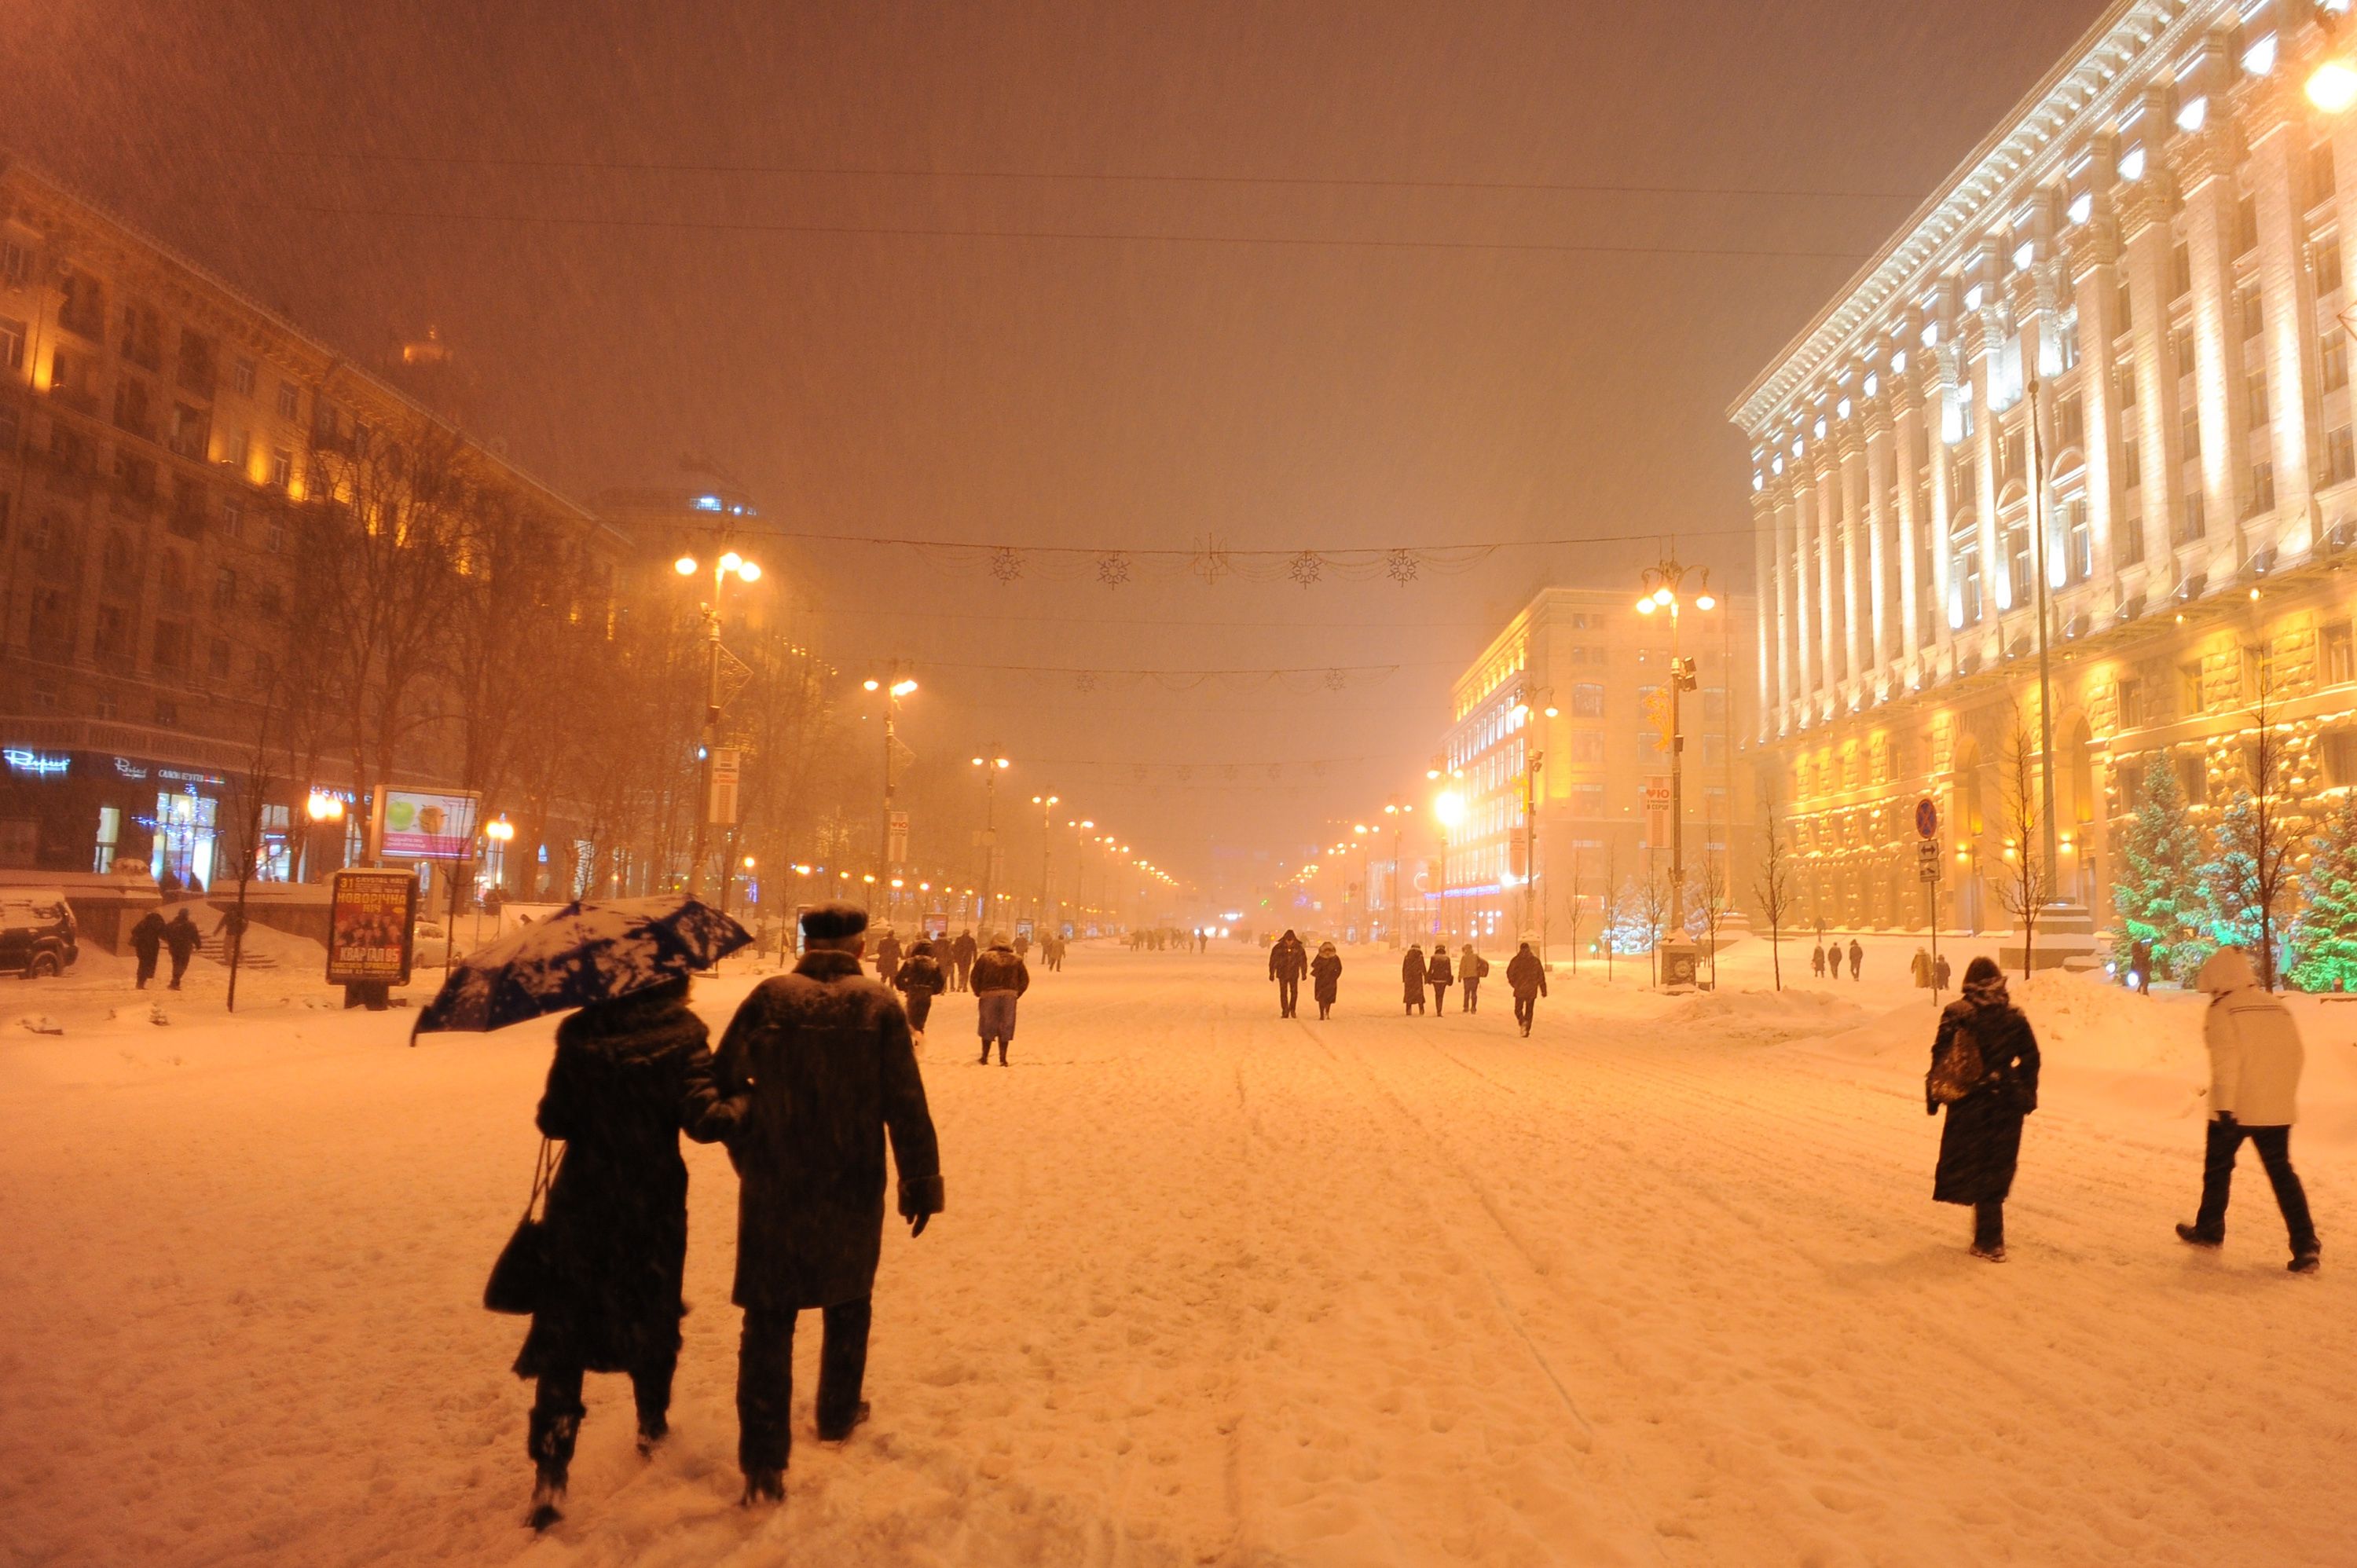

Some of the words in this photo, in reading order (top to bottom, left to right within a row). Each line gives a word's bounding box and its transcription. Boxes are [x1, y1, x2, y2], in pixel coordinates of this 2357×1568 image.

[340, 878, 354, 888] 31
[337, 893, 406, 904] НОВОРІЧНА
[340, 947, 384, 961] КВАРТАЛ
[385, 948, 401, 962] 95
